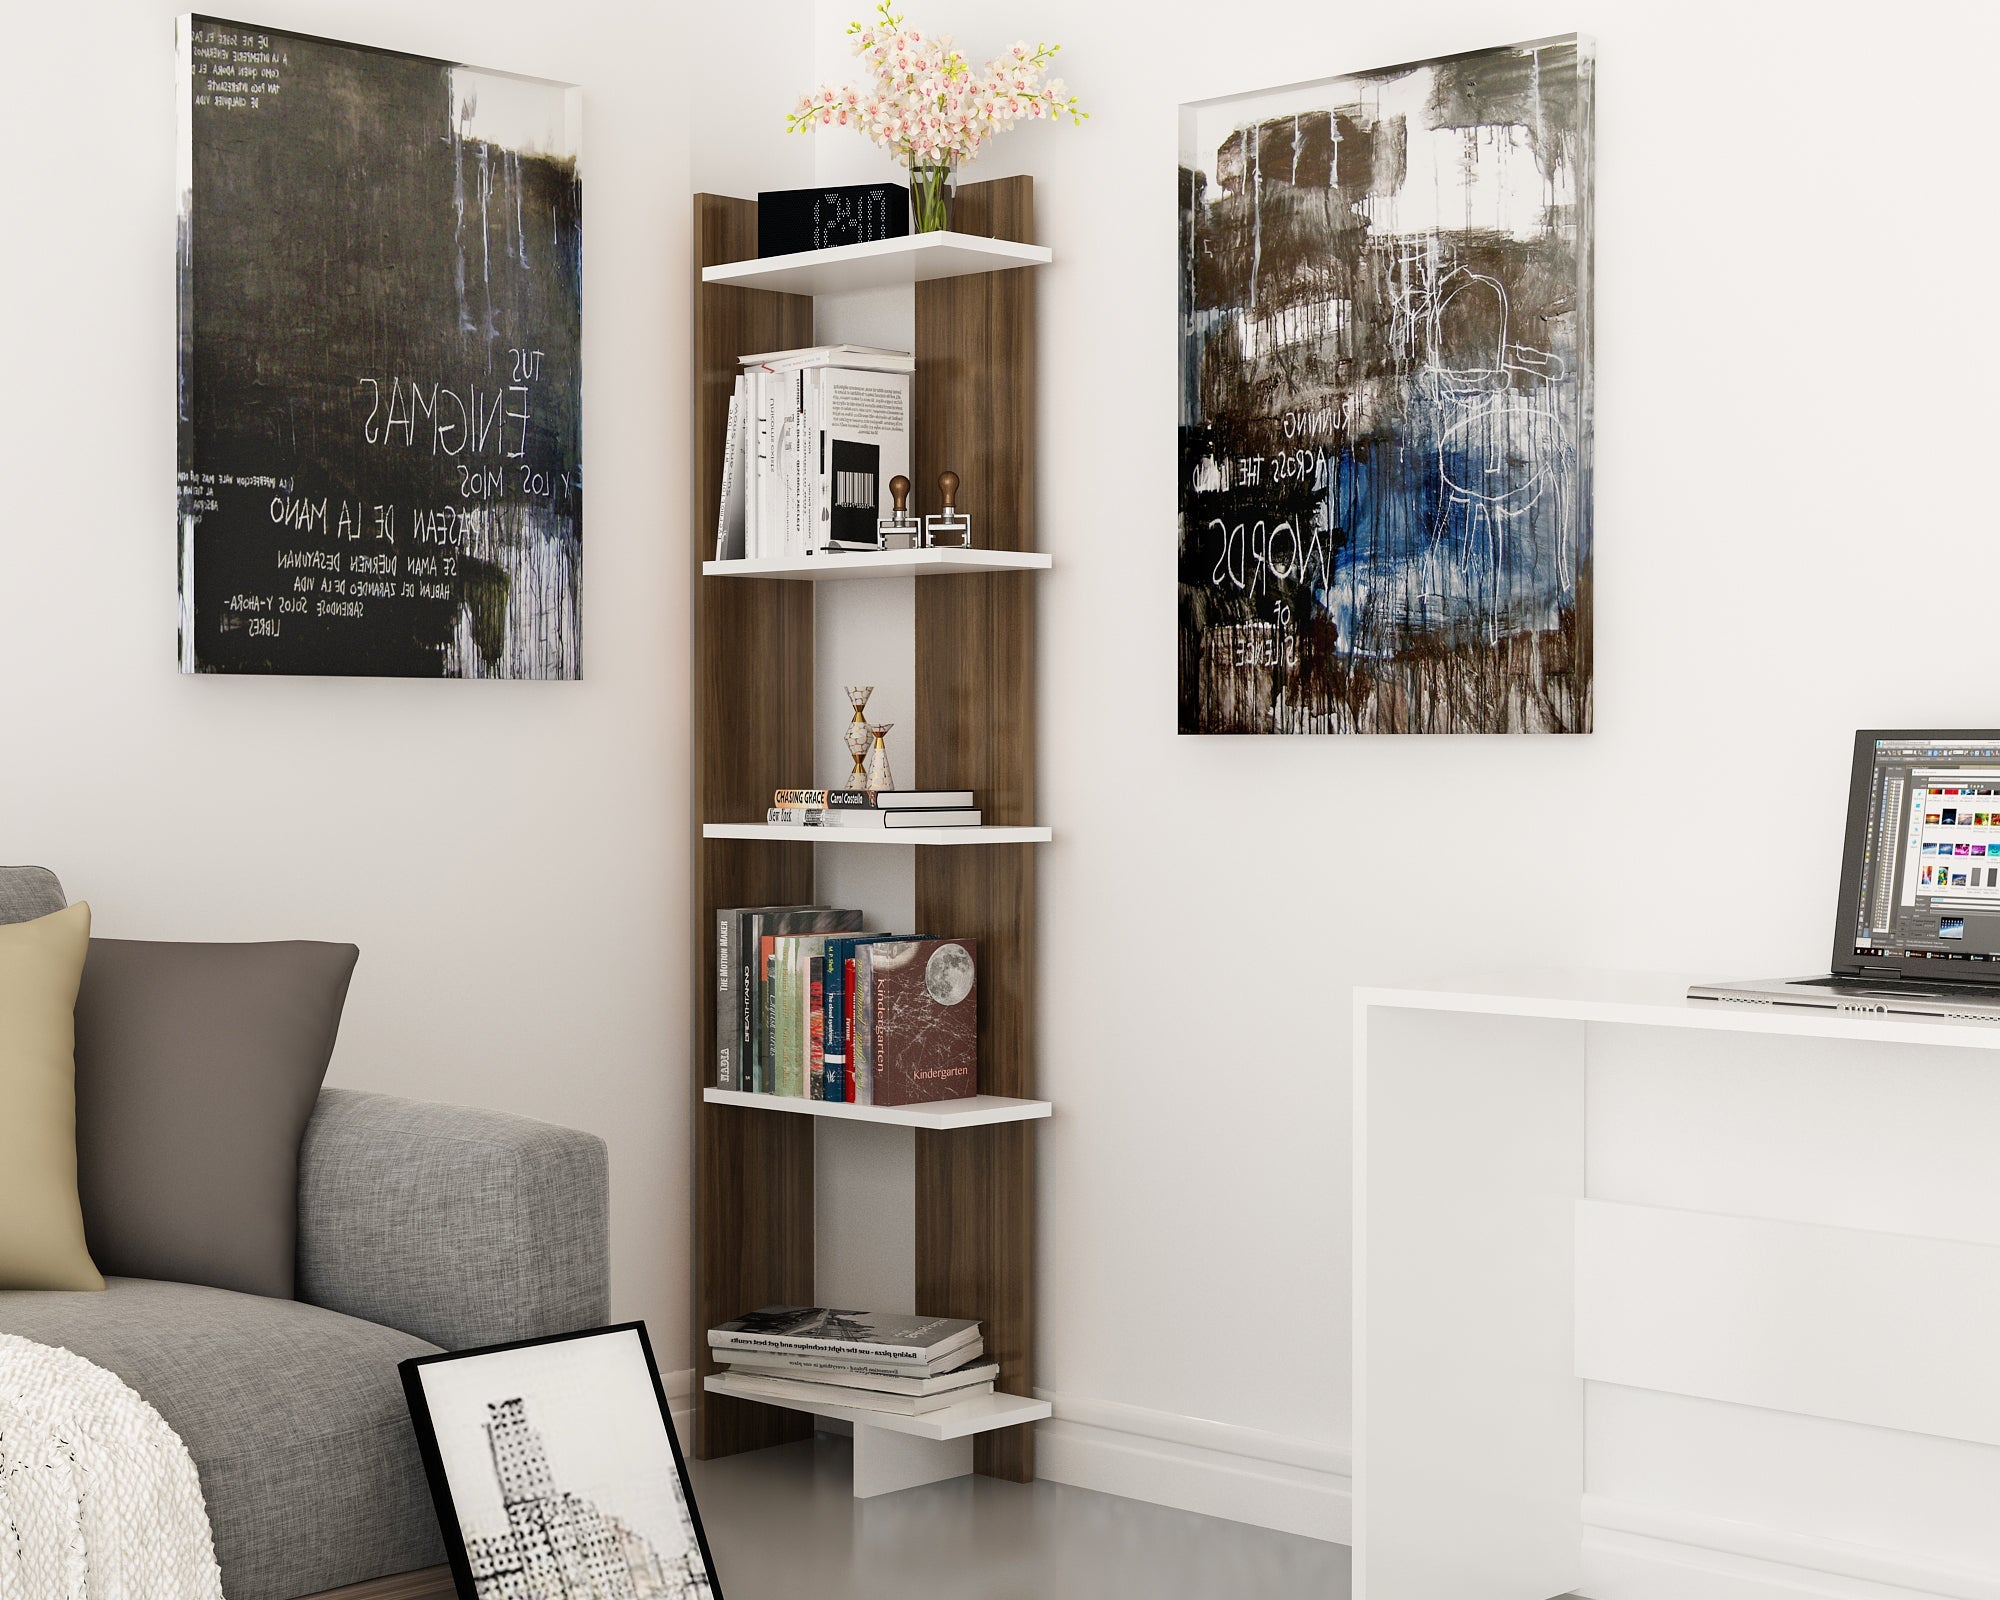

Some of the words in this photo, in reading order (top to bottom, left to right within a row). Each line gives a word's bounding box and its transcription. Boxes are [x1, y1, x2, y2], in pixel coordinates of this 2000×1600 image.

[776, 791, 804, 804] CHASING
[804, 791, 825, 804] GRACE
[830, 792, 844, 804] Carol
[720, 920, 728, 946] MAKER
[720, 948, 728, 977] MOTION
[720, 978, 728, 992] THE
[875, 978, 886, 1072] Kindergarten
[913, 1066, 968, 1080] Kindergarten
